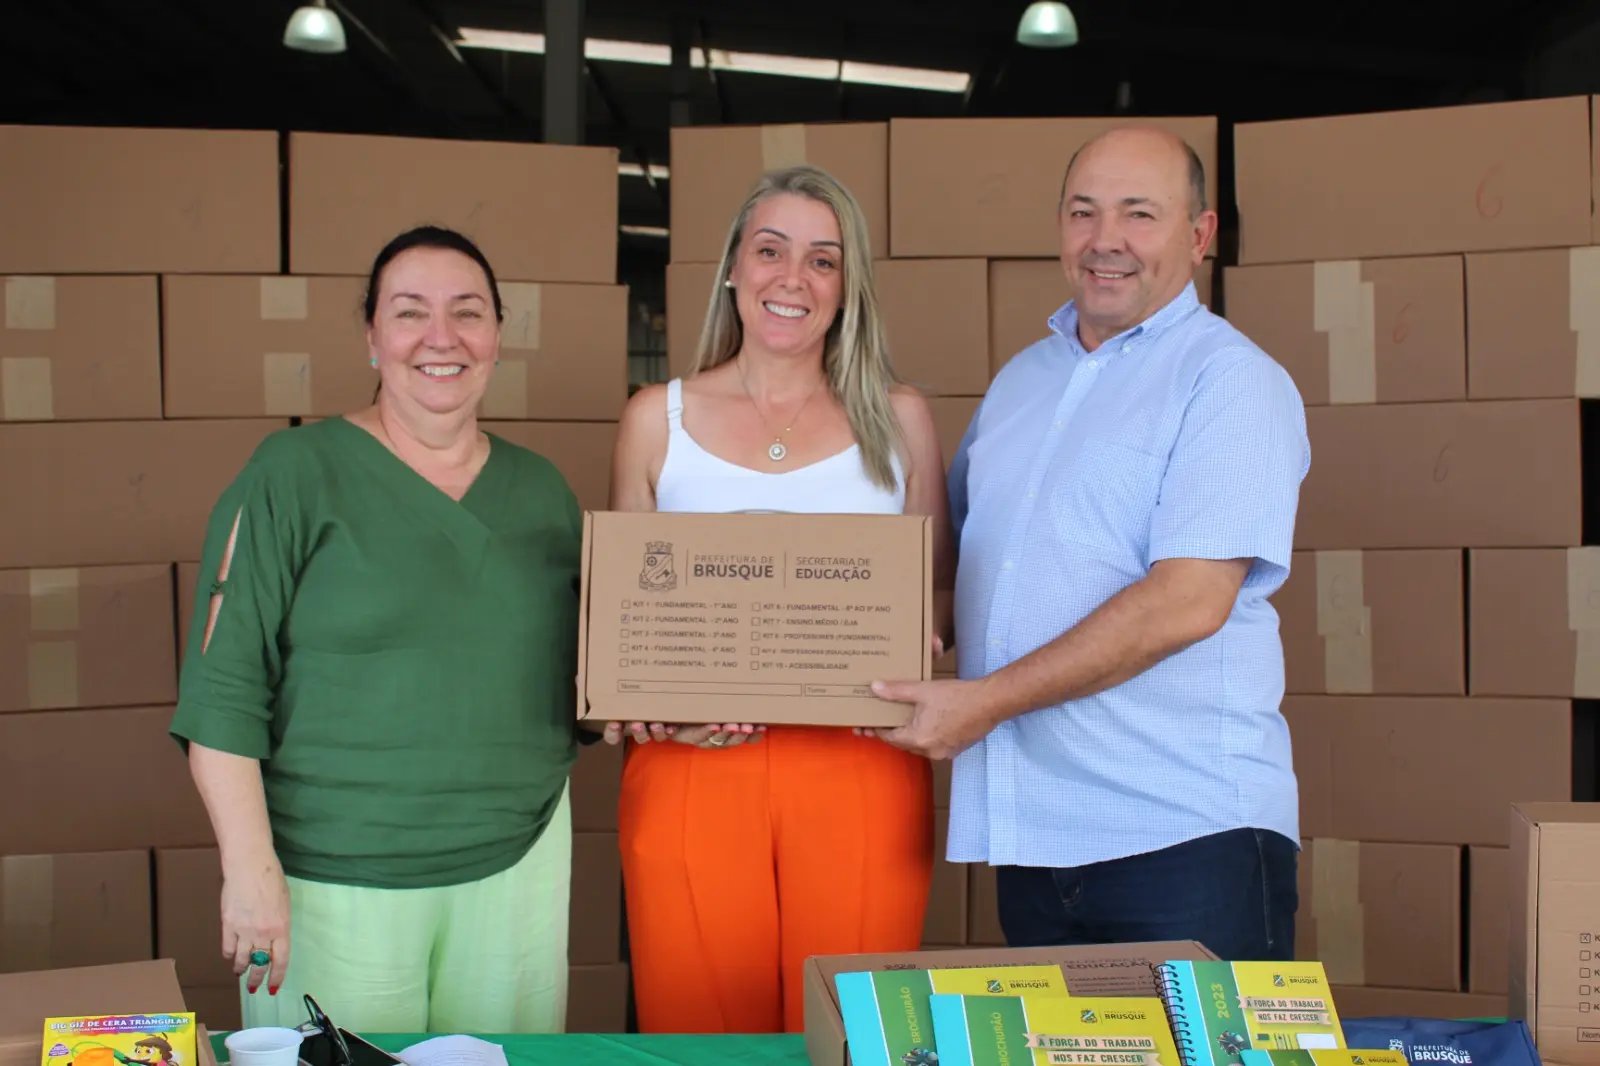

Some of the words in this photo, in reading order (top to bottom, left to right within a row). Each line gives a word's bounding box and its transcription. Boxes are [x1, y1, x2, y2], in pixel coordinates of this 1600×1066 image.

[1475, 162, 1505, 220] 6
[694, 554, 757, 564] PREFEITURA
[761, 555, 774, 564] DE
[796, 556, 856, 566] SECRETARIA
[858, 558, 871, 567] DE
[693, 563, 774, 580] BRUSQUE
[795, 566, 871, 582] EDUCAÇÃO
[655, 601, 707, 609] FUNDAMENTAL
[786, 604, 839, 612] FUNDAMENTAL
[654, 645, 706, 653] FUNDAMENTAL
[653, 660, 706, 668] FUNDAMENTAL
[1210, 983, 1231, 1019] 2023
[1254, 1000, 1275, 1008] FORÇA
[1291, 1000, 1323, 1008] TRABALHO
[1104, 1013, 1147, 1021] BRUSQUE
[1258, 1013, 1272, 1021] NOS
[1274, 1013, 1288, 1021] FAZ
[1289, 1013, 1320, 1021] CRESCER
[1038, 1038, 1045, 1047] A
[1049, 1038, 1080, 1048] FORÇA
[1084, 1039, 1098, 1047] DO
[1102, 1038, 1152, 1048] TRABALHO
[1413, 1045, 1458, 1055] PREFEITURA
[1053, 1054, 1073, 1063] NOS
[1077, 1054, 1096, 1063] FAZ
[1101, 1054, 1144, 1063] CRESCER
[1414, 1050, 1473, 1065] BRUSQUE
